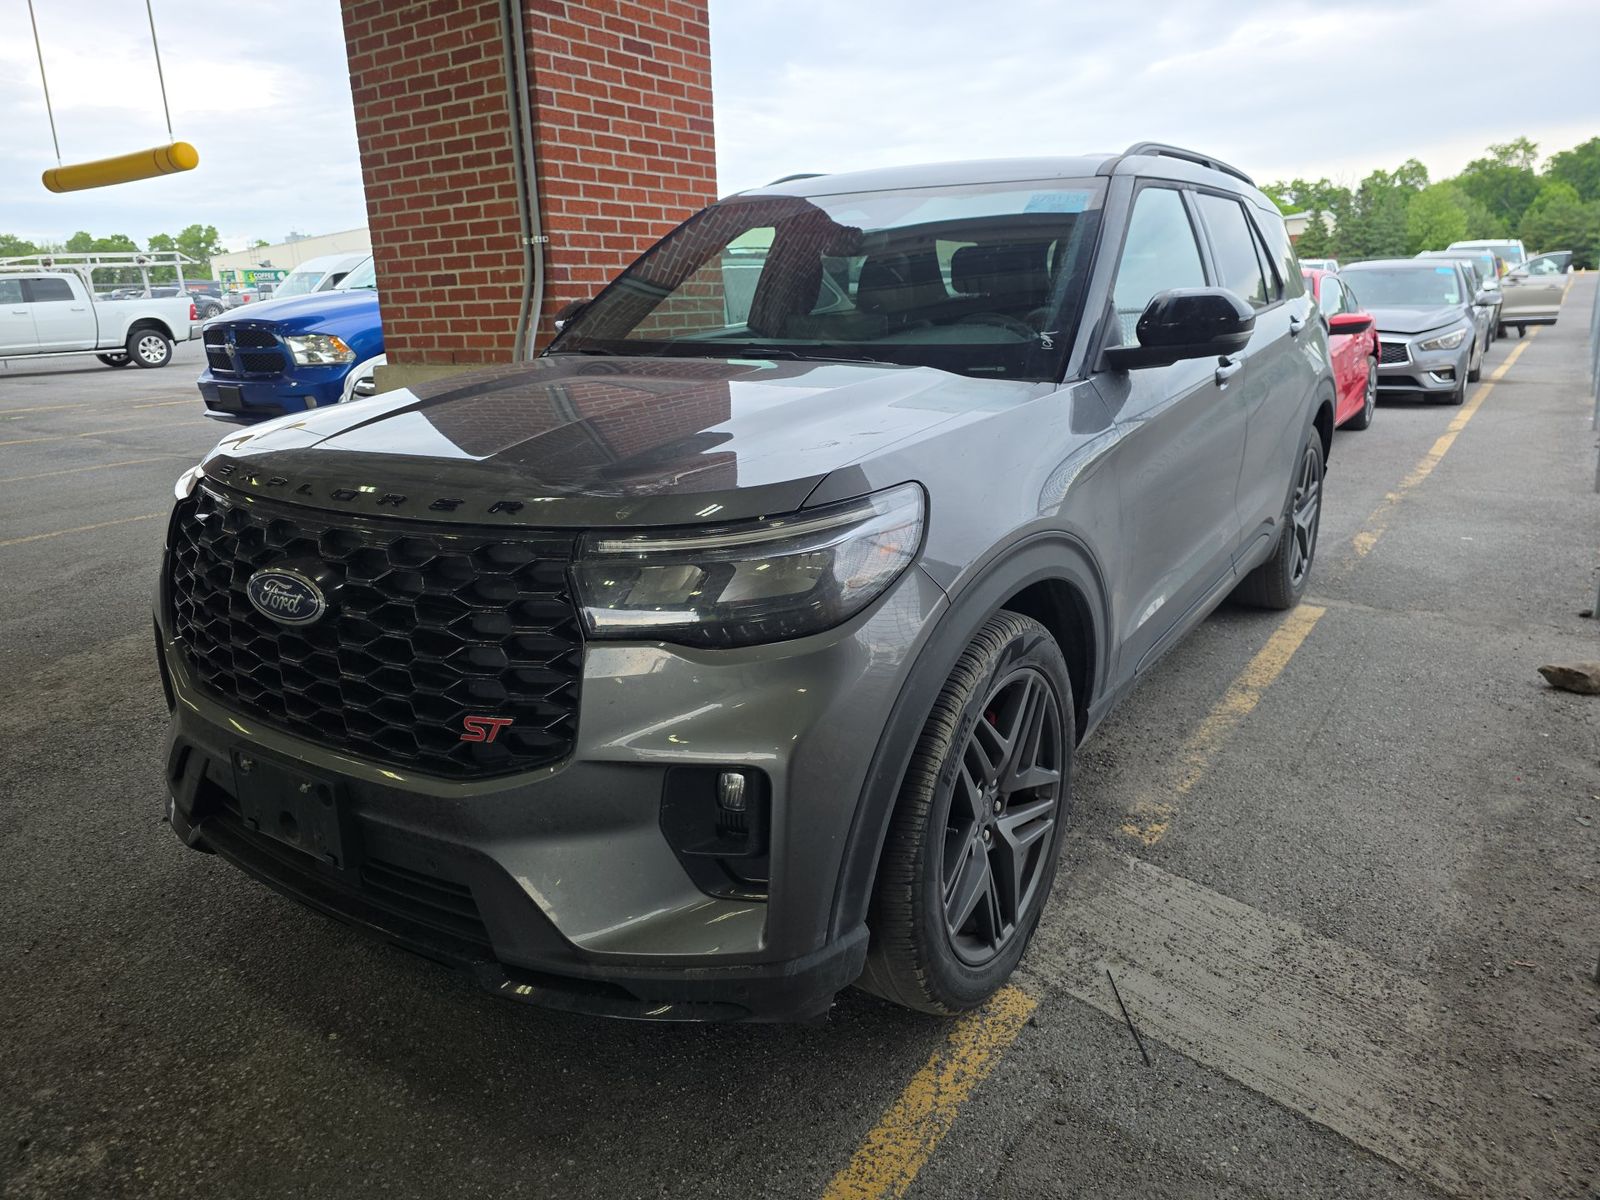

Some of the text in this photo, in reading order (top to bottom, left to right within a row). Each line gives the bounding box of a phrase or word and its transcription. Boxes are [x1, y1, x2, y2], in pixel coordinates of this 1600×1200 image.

[254, 272, 275, 280] COFFEE
[219, 464, 525, 515] EXPLORER
[260, 579, 305, 613] Ford
[460, 715, 514, 743] ST
